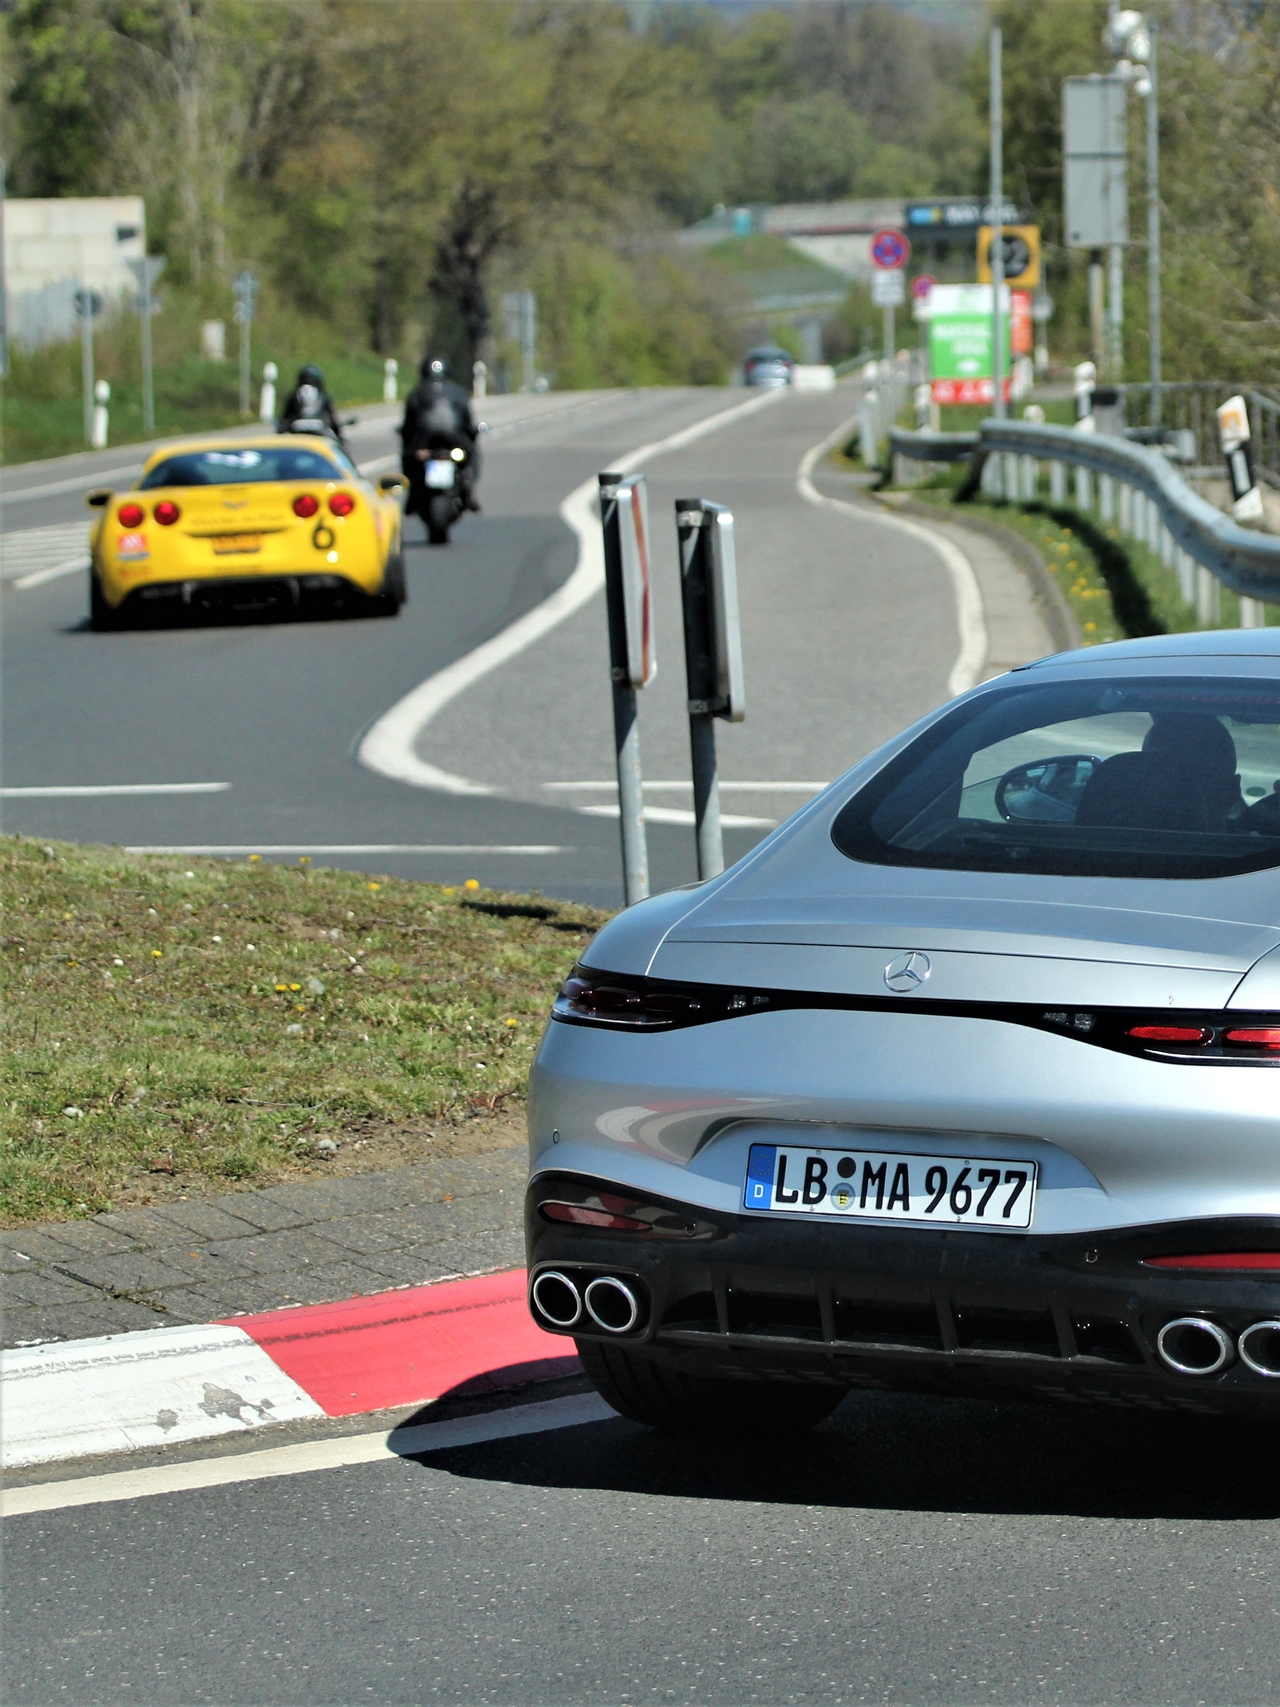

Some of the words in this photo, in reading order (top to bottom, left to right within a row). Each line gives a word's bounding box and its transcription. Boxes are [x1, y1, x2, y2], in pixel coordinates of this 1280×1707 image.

[311, 514, 336, 550] 6
[753, 1184, 764, 1199] D
[776, 1155, 829, 1204] LB
[860, 1161, 910, 1211] MA
[925, 1166, 1028, 1218] 9677
